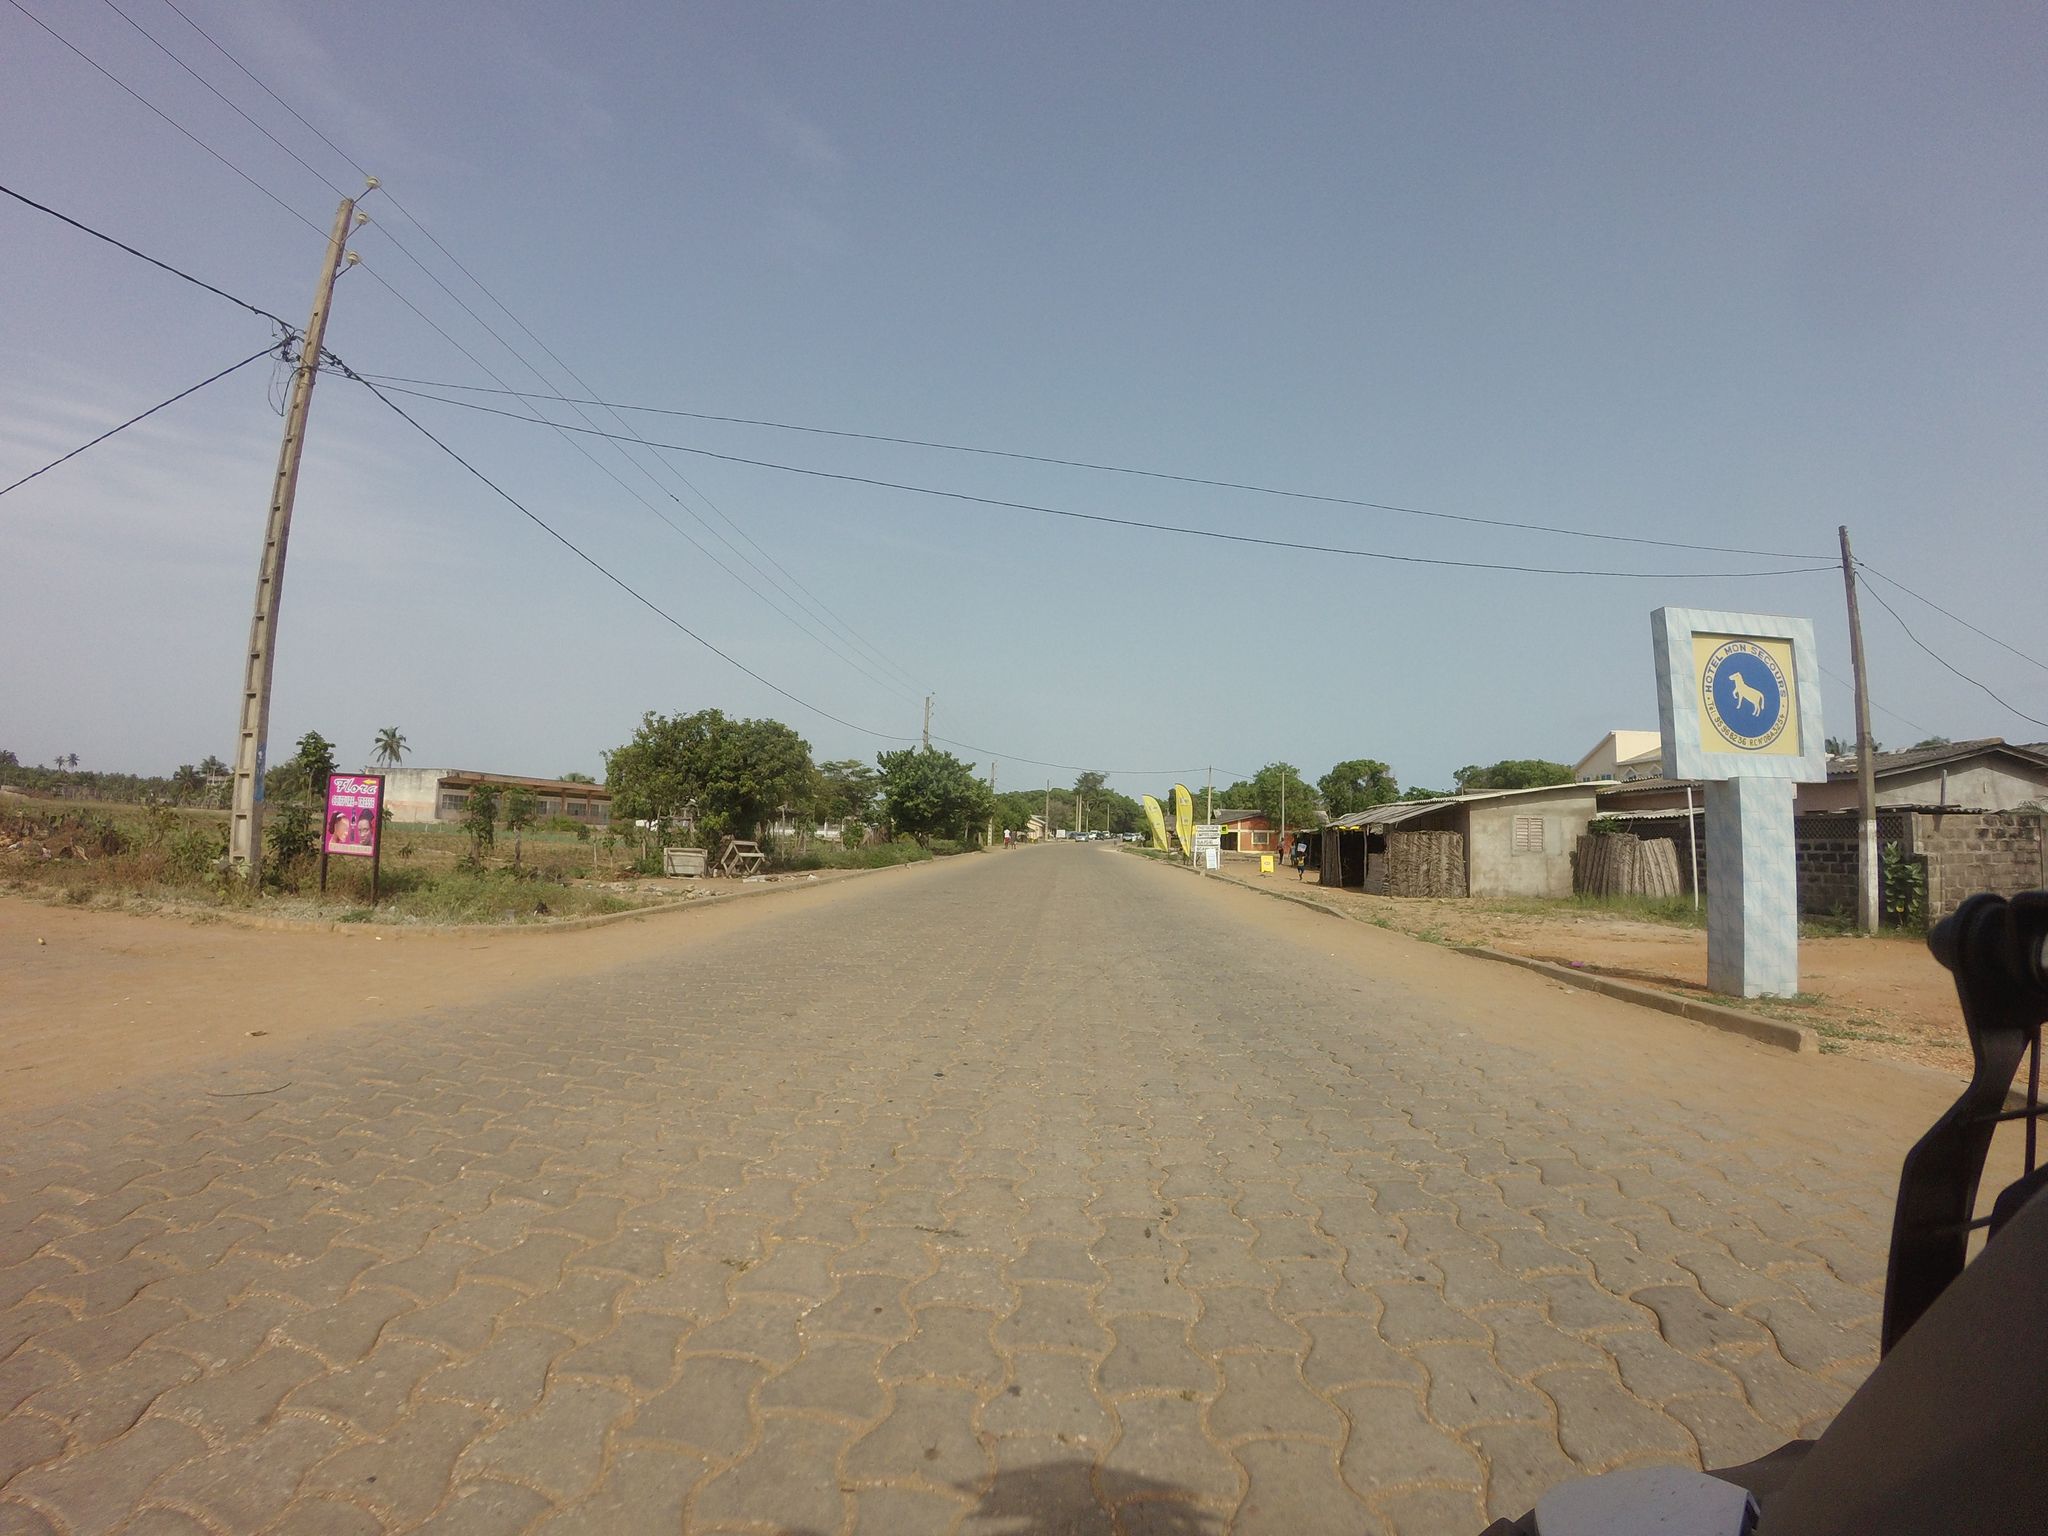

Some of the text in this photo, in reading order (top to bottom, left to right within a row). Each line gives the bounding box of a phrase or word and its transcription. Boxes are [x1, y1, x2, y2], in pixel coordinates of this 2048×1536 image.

[1705, 644, 1787, 698] HOTEL MON SECOURS
[334, 778, 378, 795] Flora
